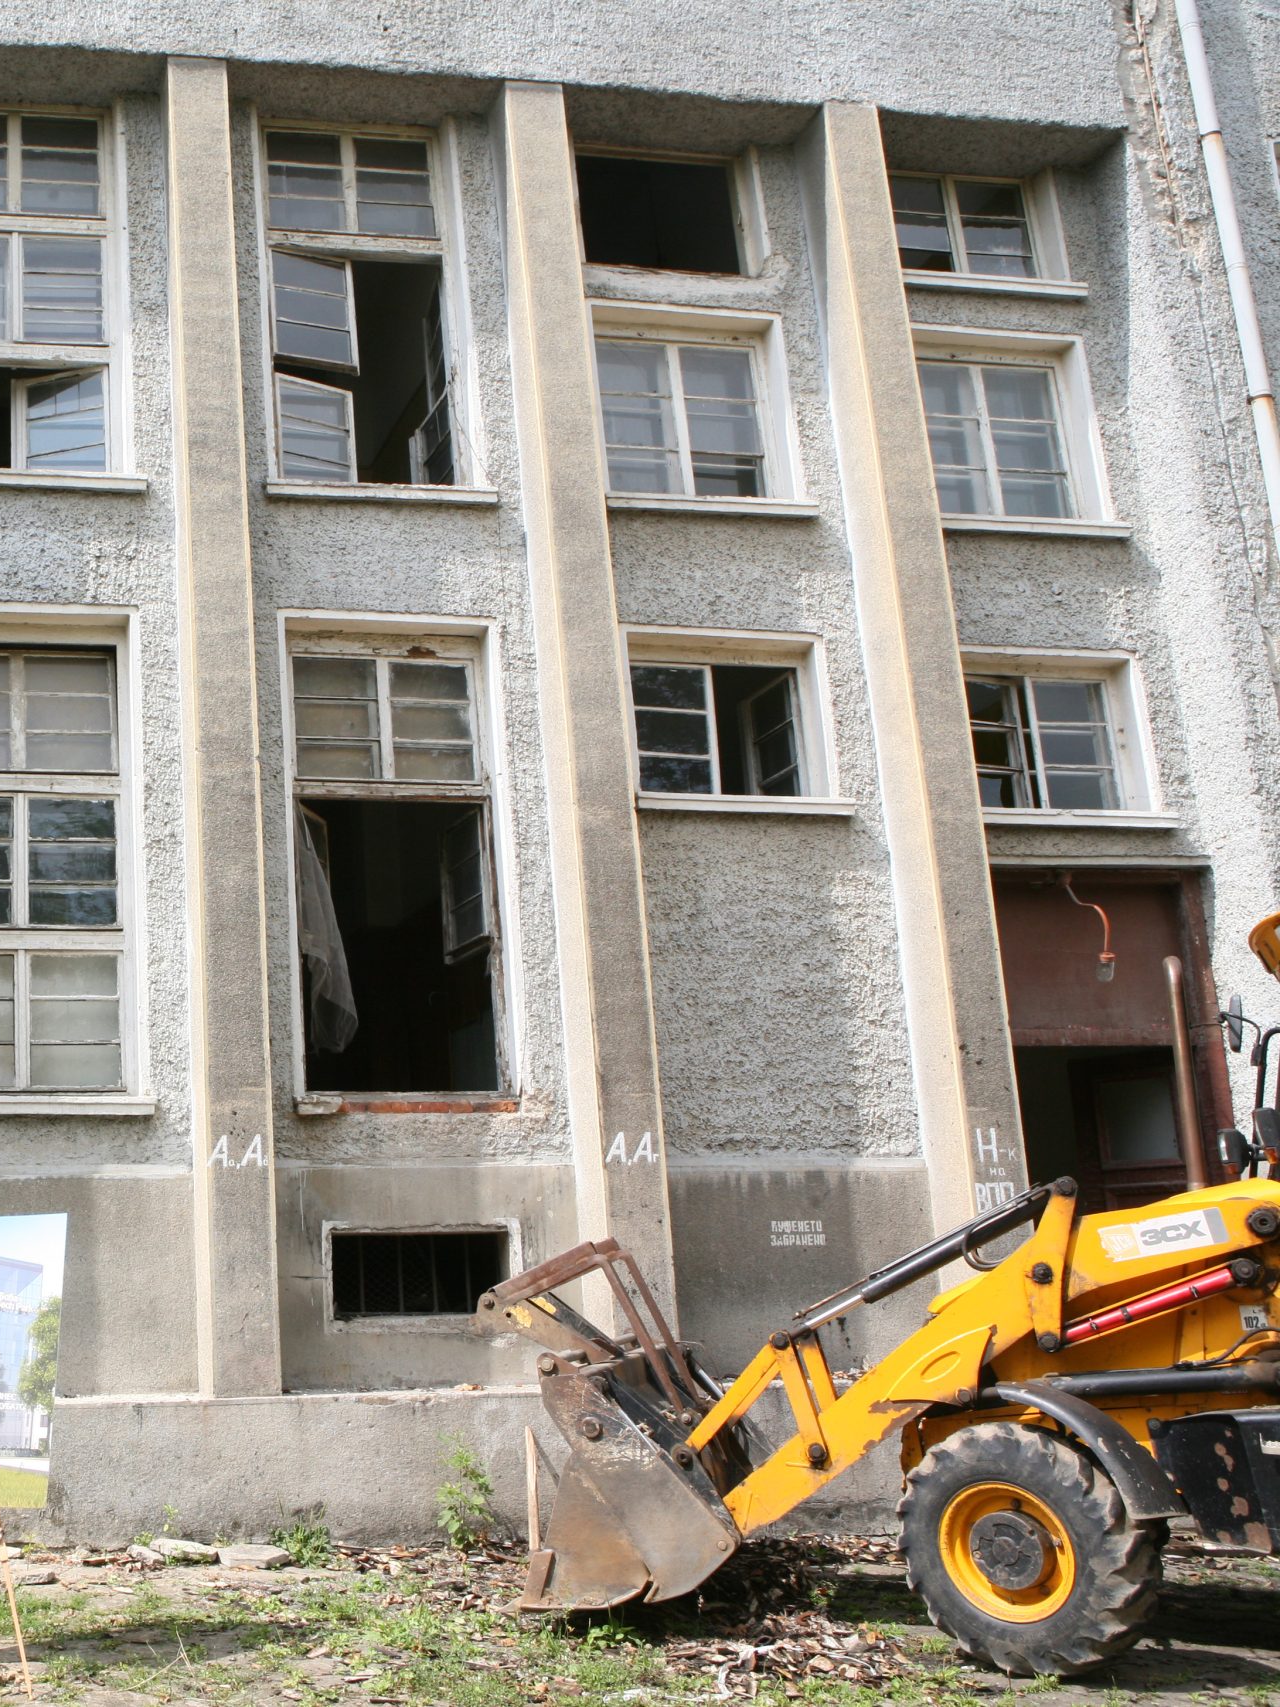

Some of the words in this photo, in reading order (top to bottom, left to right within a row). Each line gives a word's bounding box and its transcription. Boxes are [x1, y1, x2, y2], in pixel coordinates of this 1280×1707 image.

[1140, 1220, 1207, 1246] 3CX
[770, 1234, 826, 1246] ЗАБРАНЕНО
[1243, 1316, 1260, 1328] 102
